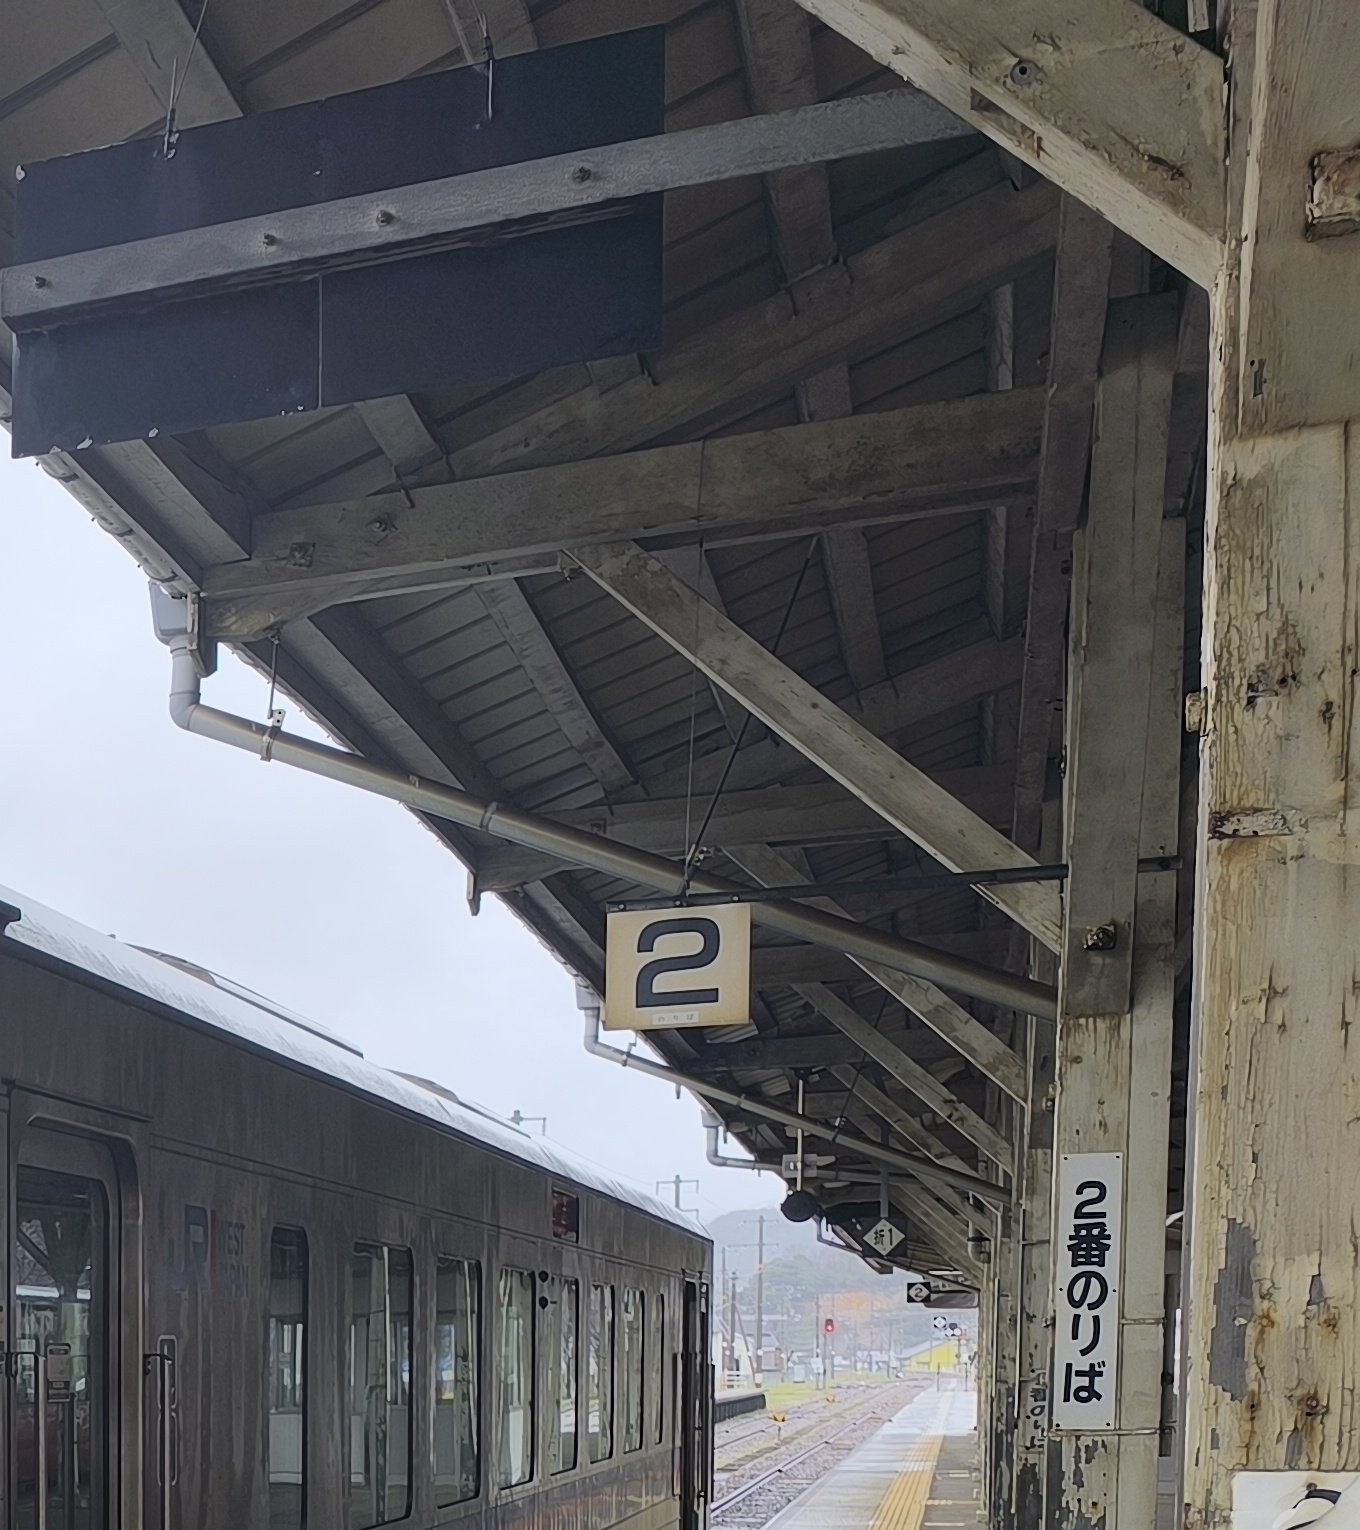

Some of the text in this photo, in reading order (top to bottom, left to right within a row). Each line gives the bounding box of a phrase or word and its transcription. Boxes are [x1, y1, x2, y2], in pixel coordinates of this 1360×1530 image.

[636, 917, 721, 1009] 2
[914, 1286, 924, 1299] 2
[1062, 1180, 1112, 1404] 2番のりば
